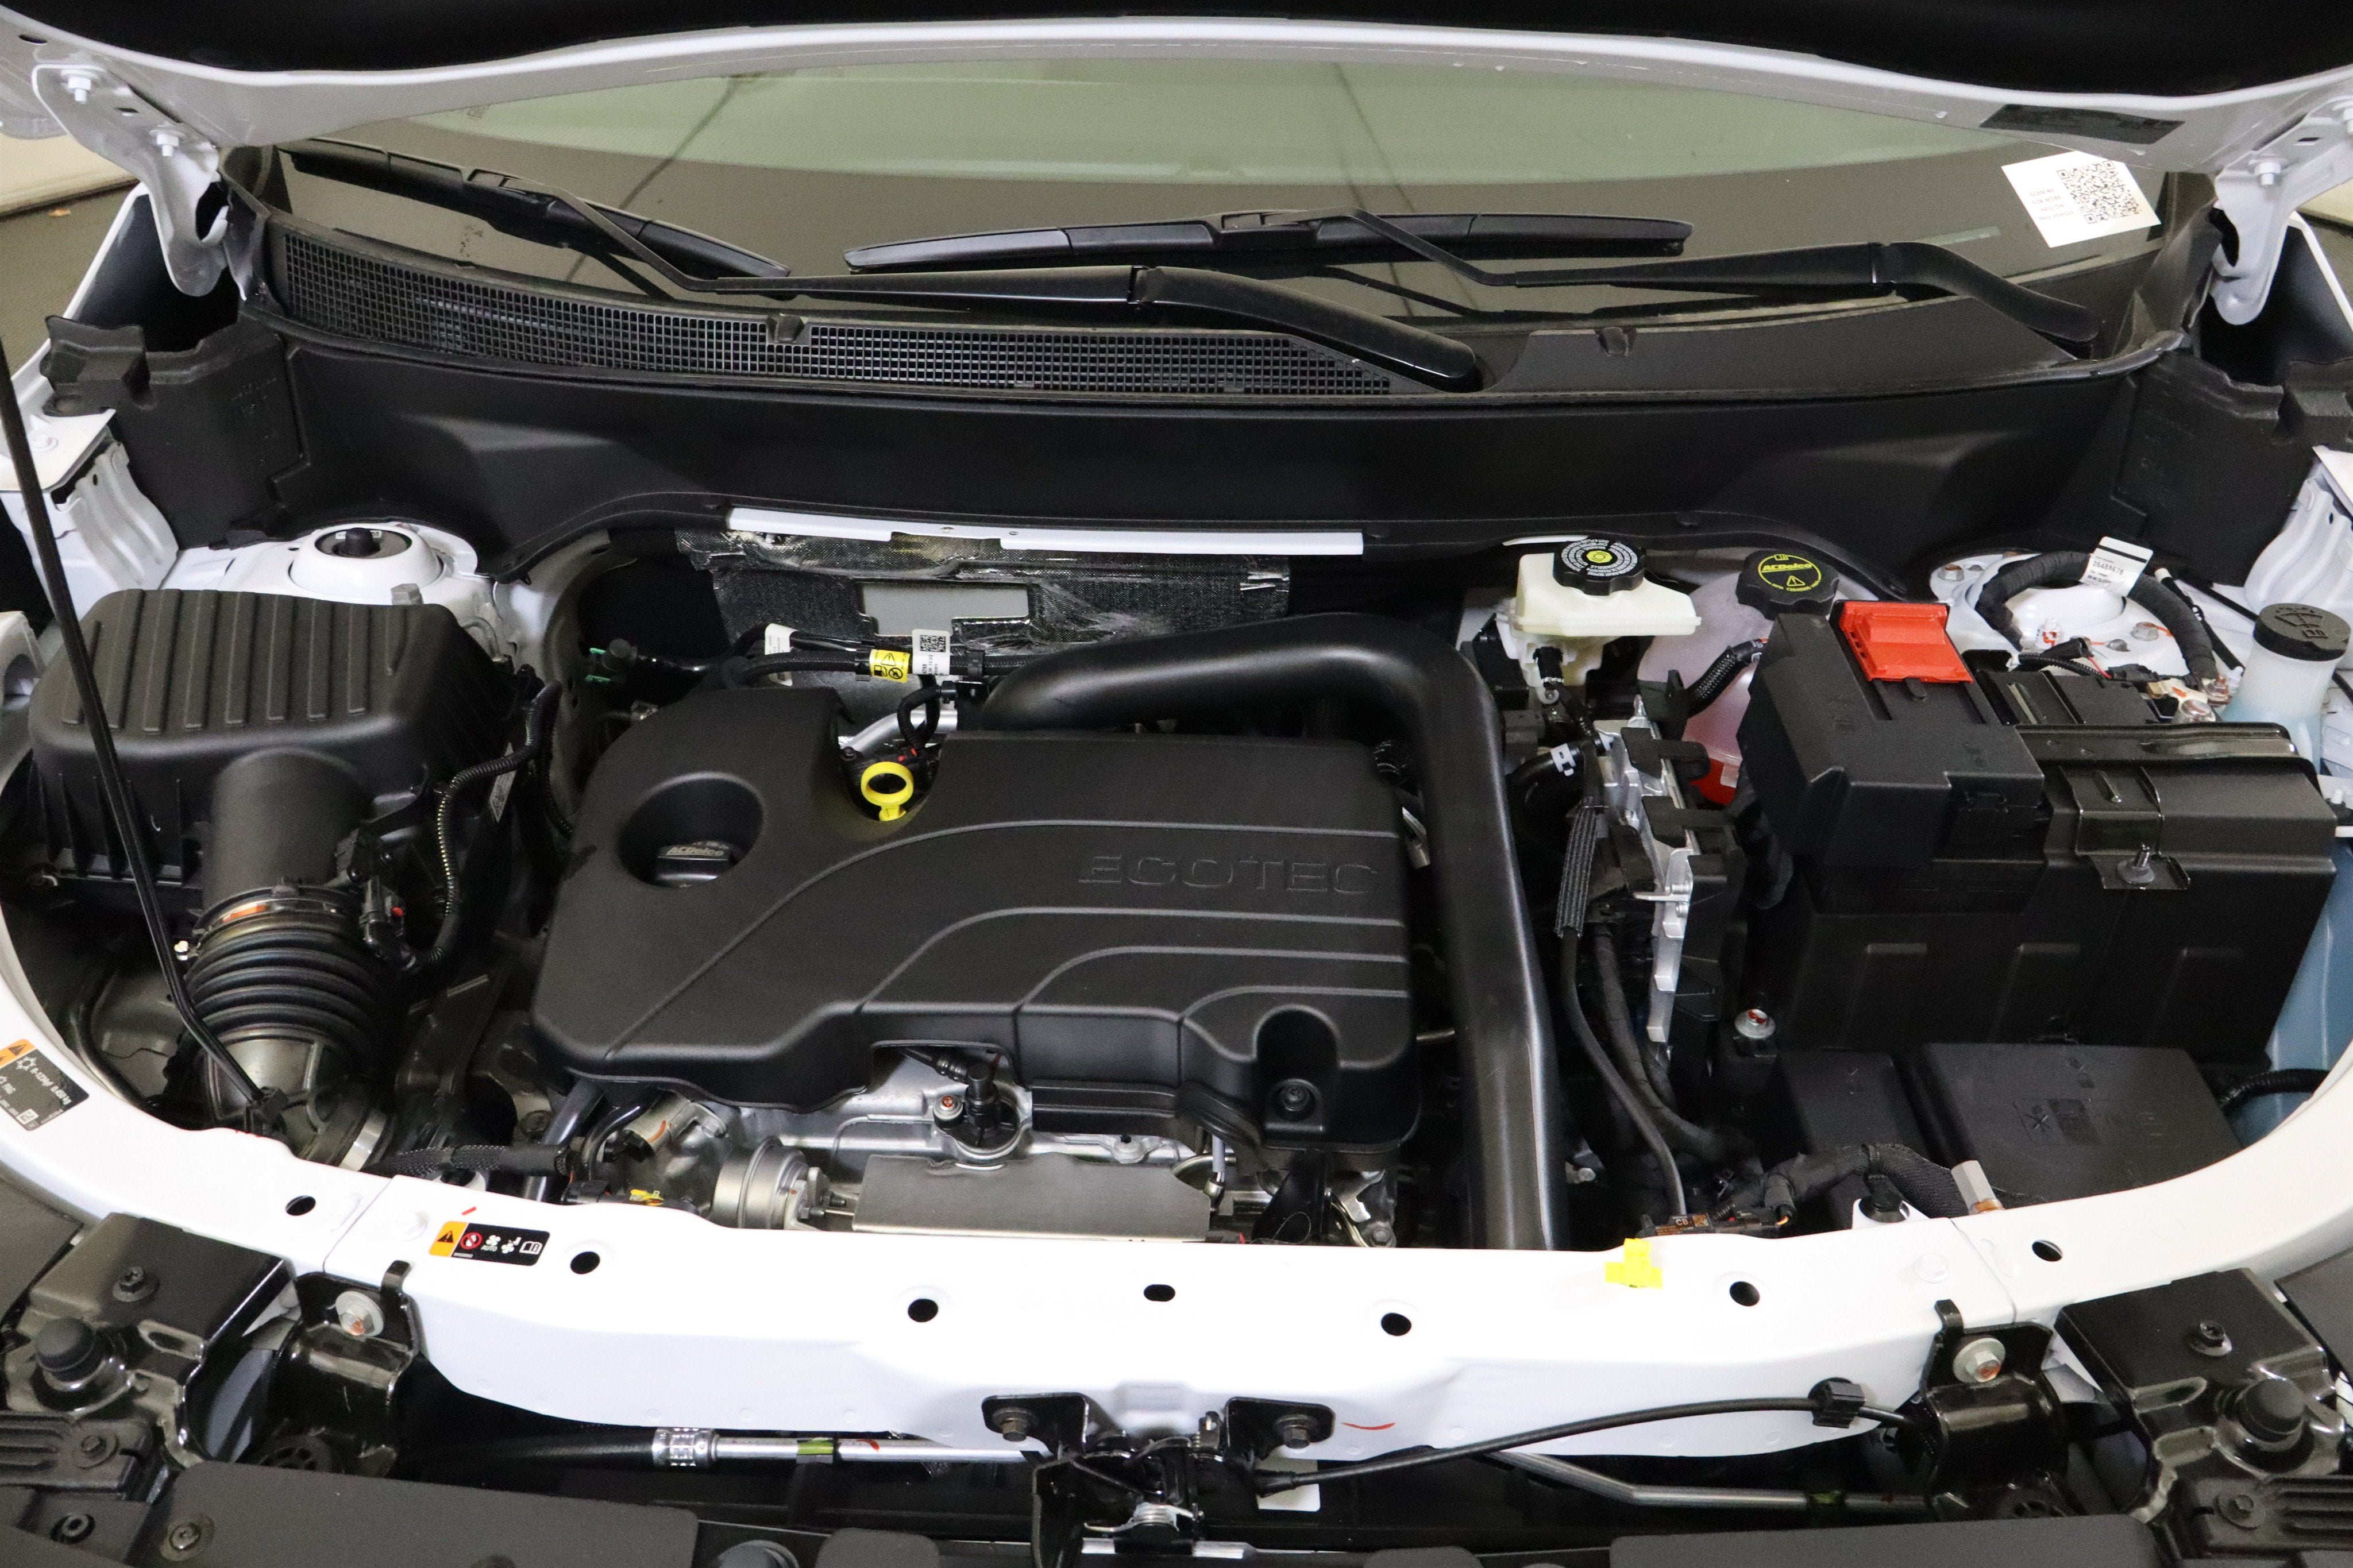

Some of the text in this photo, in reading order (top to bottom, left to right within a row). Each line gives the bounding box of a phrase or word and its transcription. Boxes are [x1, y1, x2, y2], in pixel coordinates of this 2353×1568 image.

[1761, 563, 1813, 571] ACDelco
[666, 846, 724, 856] ACDelco
[1078, 855, 1378, 896] ECOTEC
